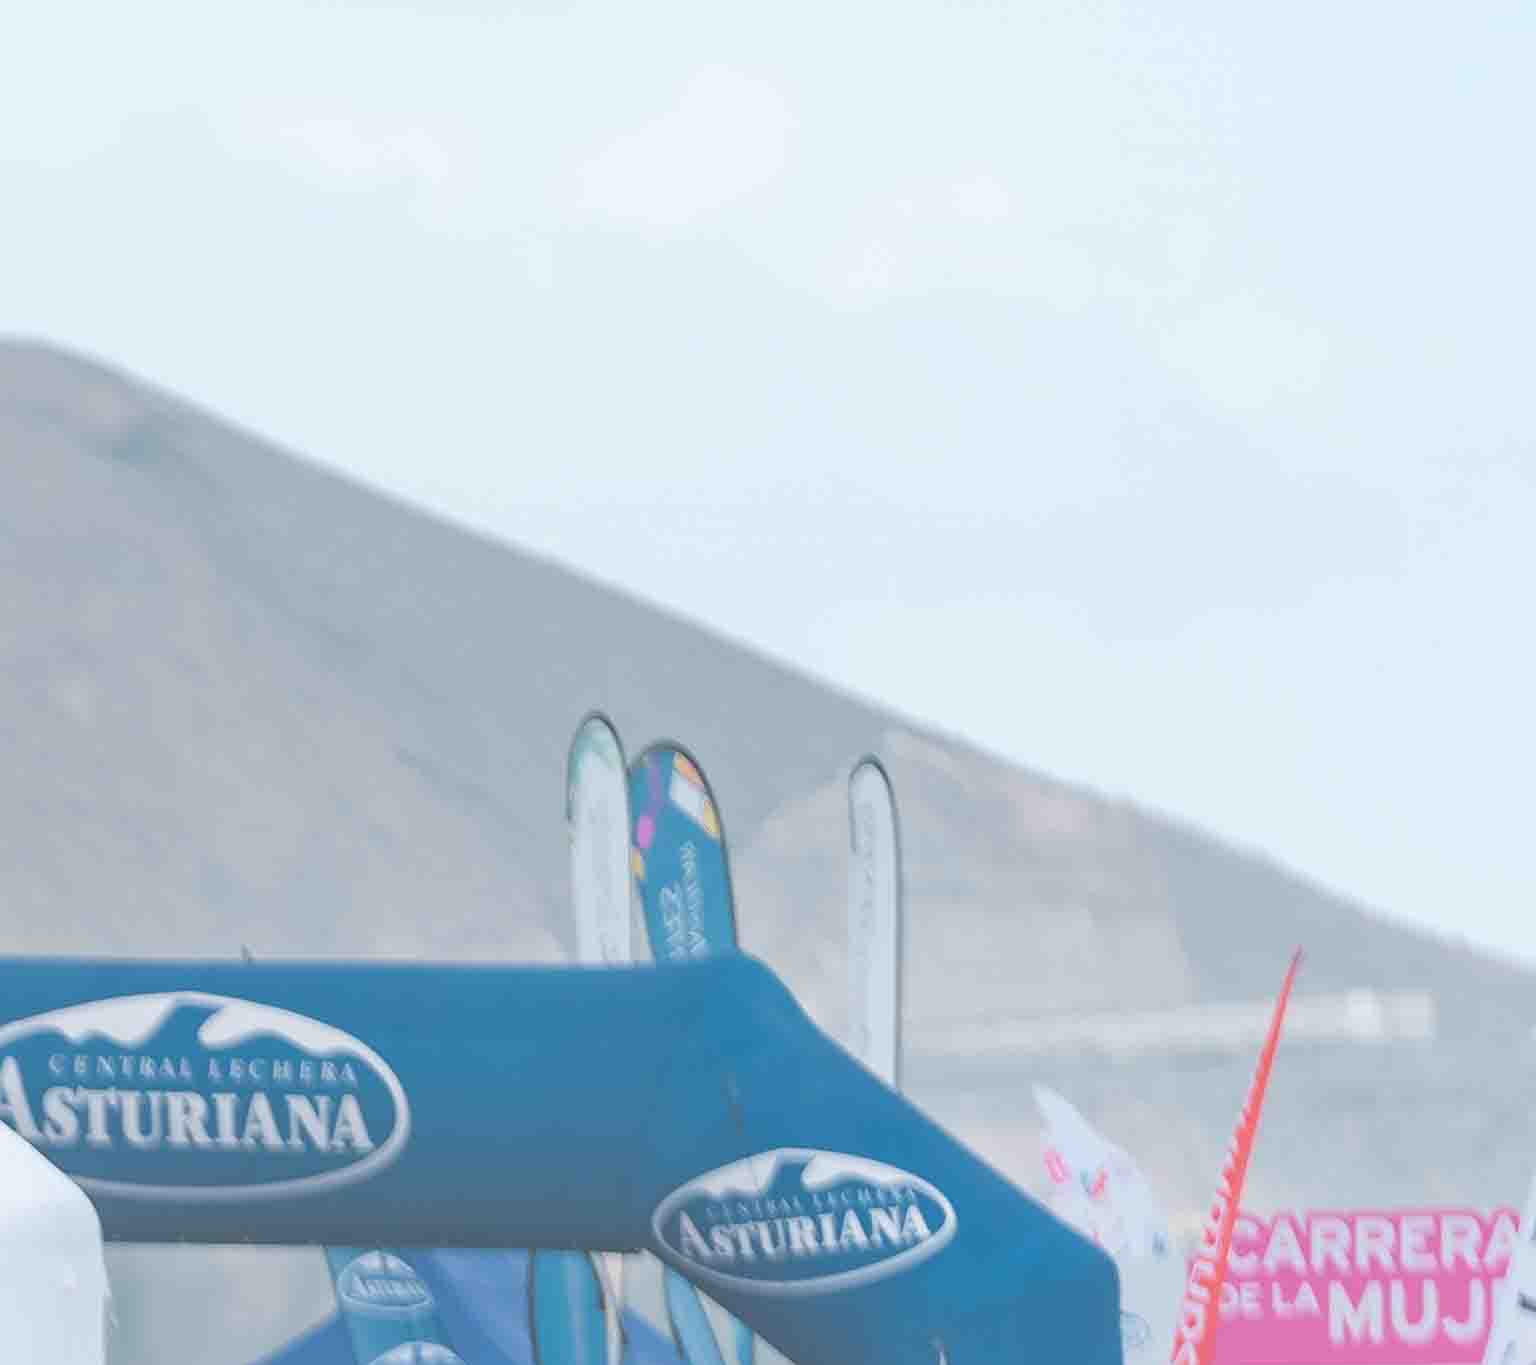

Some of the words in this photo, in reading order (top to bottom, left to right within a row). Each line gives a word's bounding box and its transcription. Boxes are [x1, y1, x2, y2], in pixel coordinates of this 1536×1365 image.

[48, 1053, 192, 1080] CENTRAL
[208, 1056, 358, 1085] LECHERA
[679, 1203, 933, 1259] ASTURIANA
[1228, 1214, 1516, 1272] CARRERA
[1218, 1281, 1265, 1318] DE
[1271, 1281, 1321, 1318] LA
[1327, 1278, 1502, 1345] MUJ
